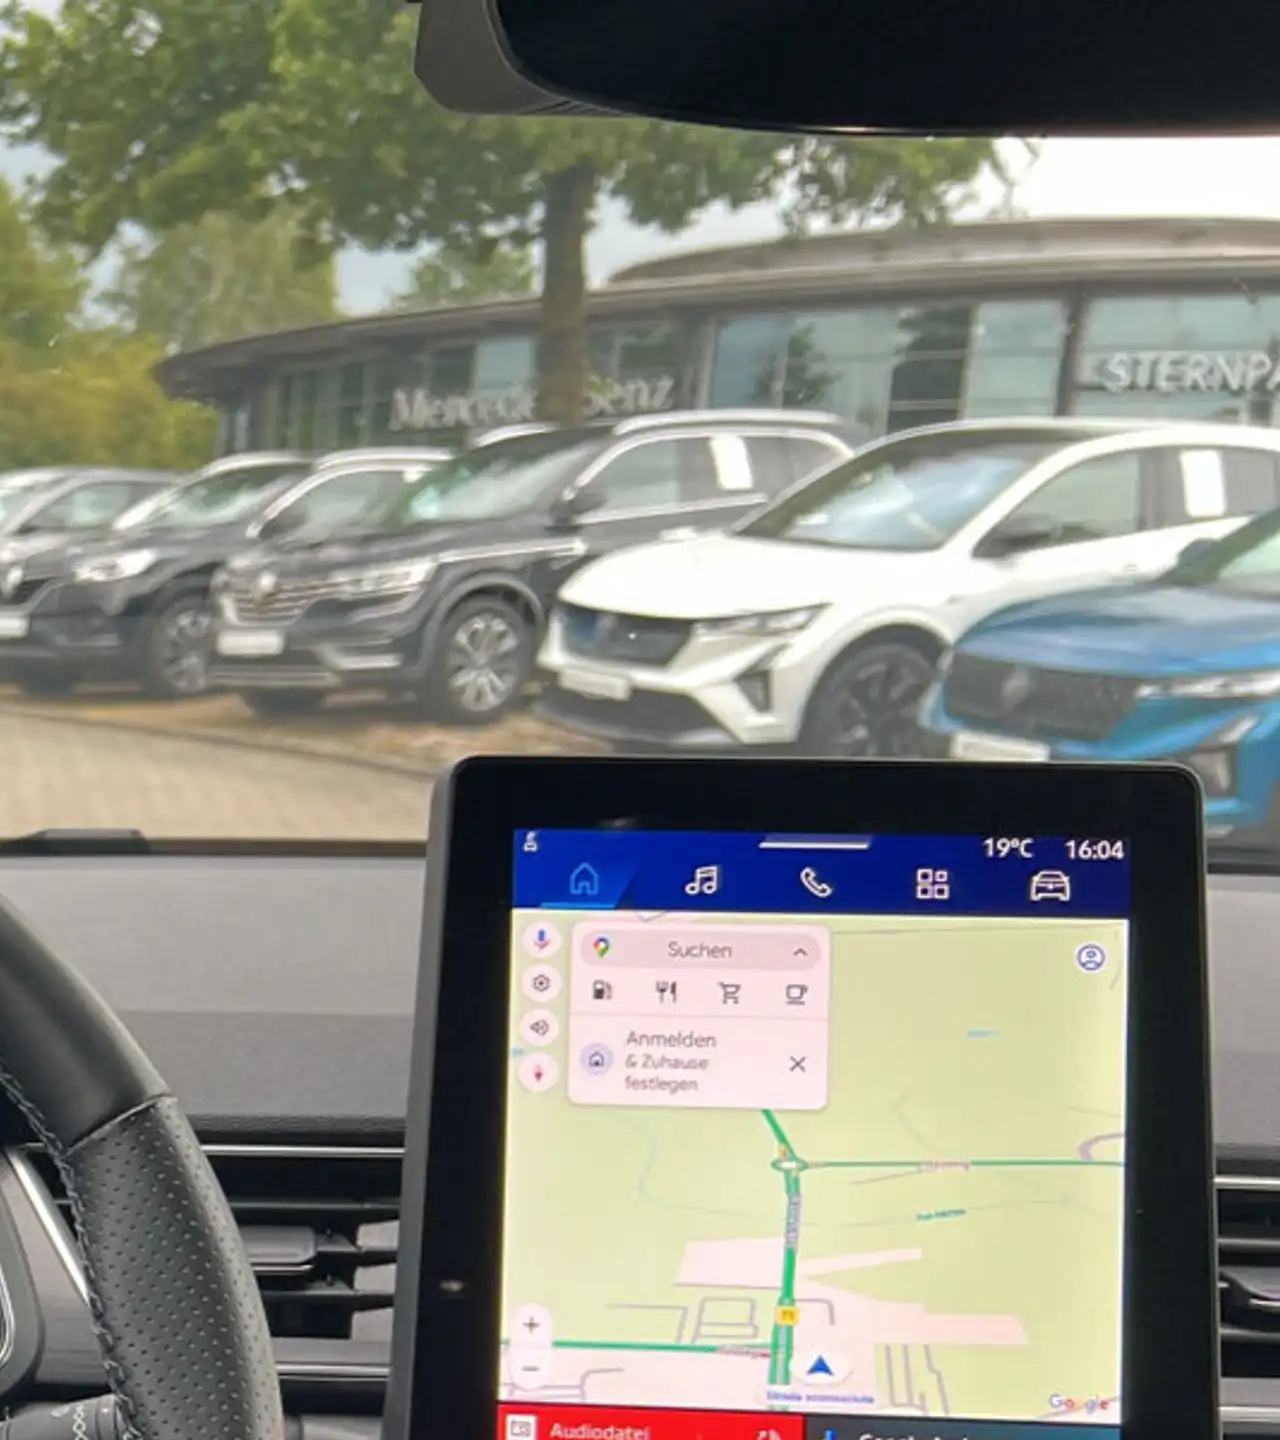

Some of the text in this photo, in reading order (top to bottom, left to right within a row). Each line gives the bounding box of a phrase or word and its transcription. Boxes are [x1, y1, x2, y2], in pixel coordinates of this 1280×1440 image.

[1065, 839, 1125, 860] 16:04
[667, 941, 732, 959] Suchen
[625, 1030, 717, 1049] Anmelden
[641, 1054, 709, 1071] Zuhause
[624, 1076, 699, 1095] festlegen
